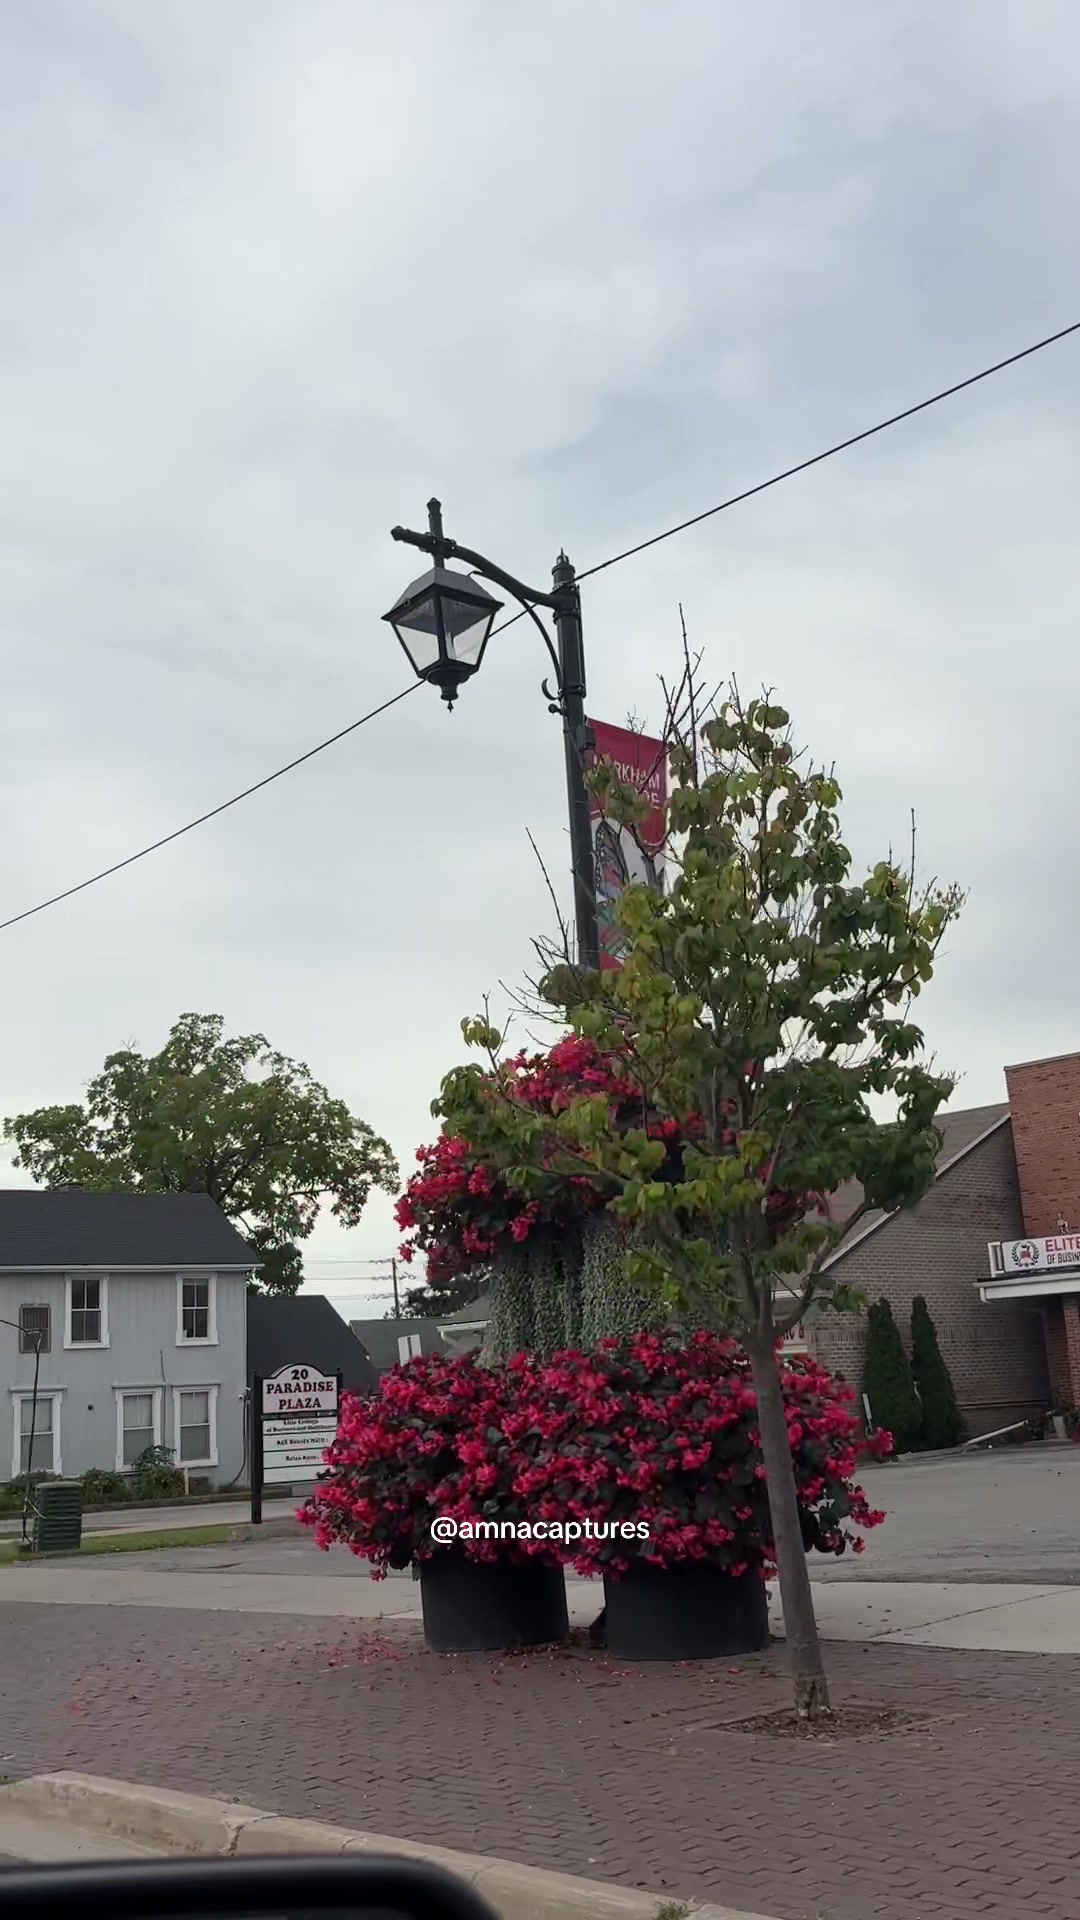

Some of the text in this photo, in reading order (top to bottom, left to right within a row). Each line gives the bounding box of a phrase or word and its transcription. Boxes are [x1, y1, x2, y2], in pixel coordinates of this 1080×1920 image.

[1047, 1252, 1080, 1265] OF BUSIN
[291, 1369, 309, 1380] 20
[266, 1381, 334, 1394] PARADISE
[279, 1397, 322, 1410] PLAZA
